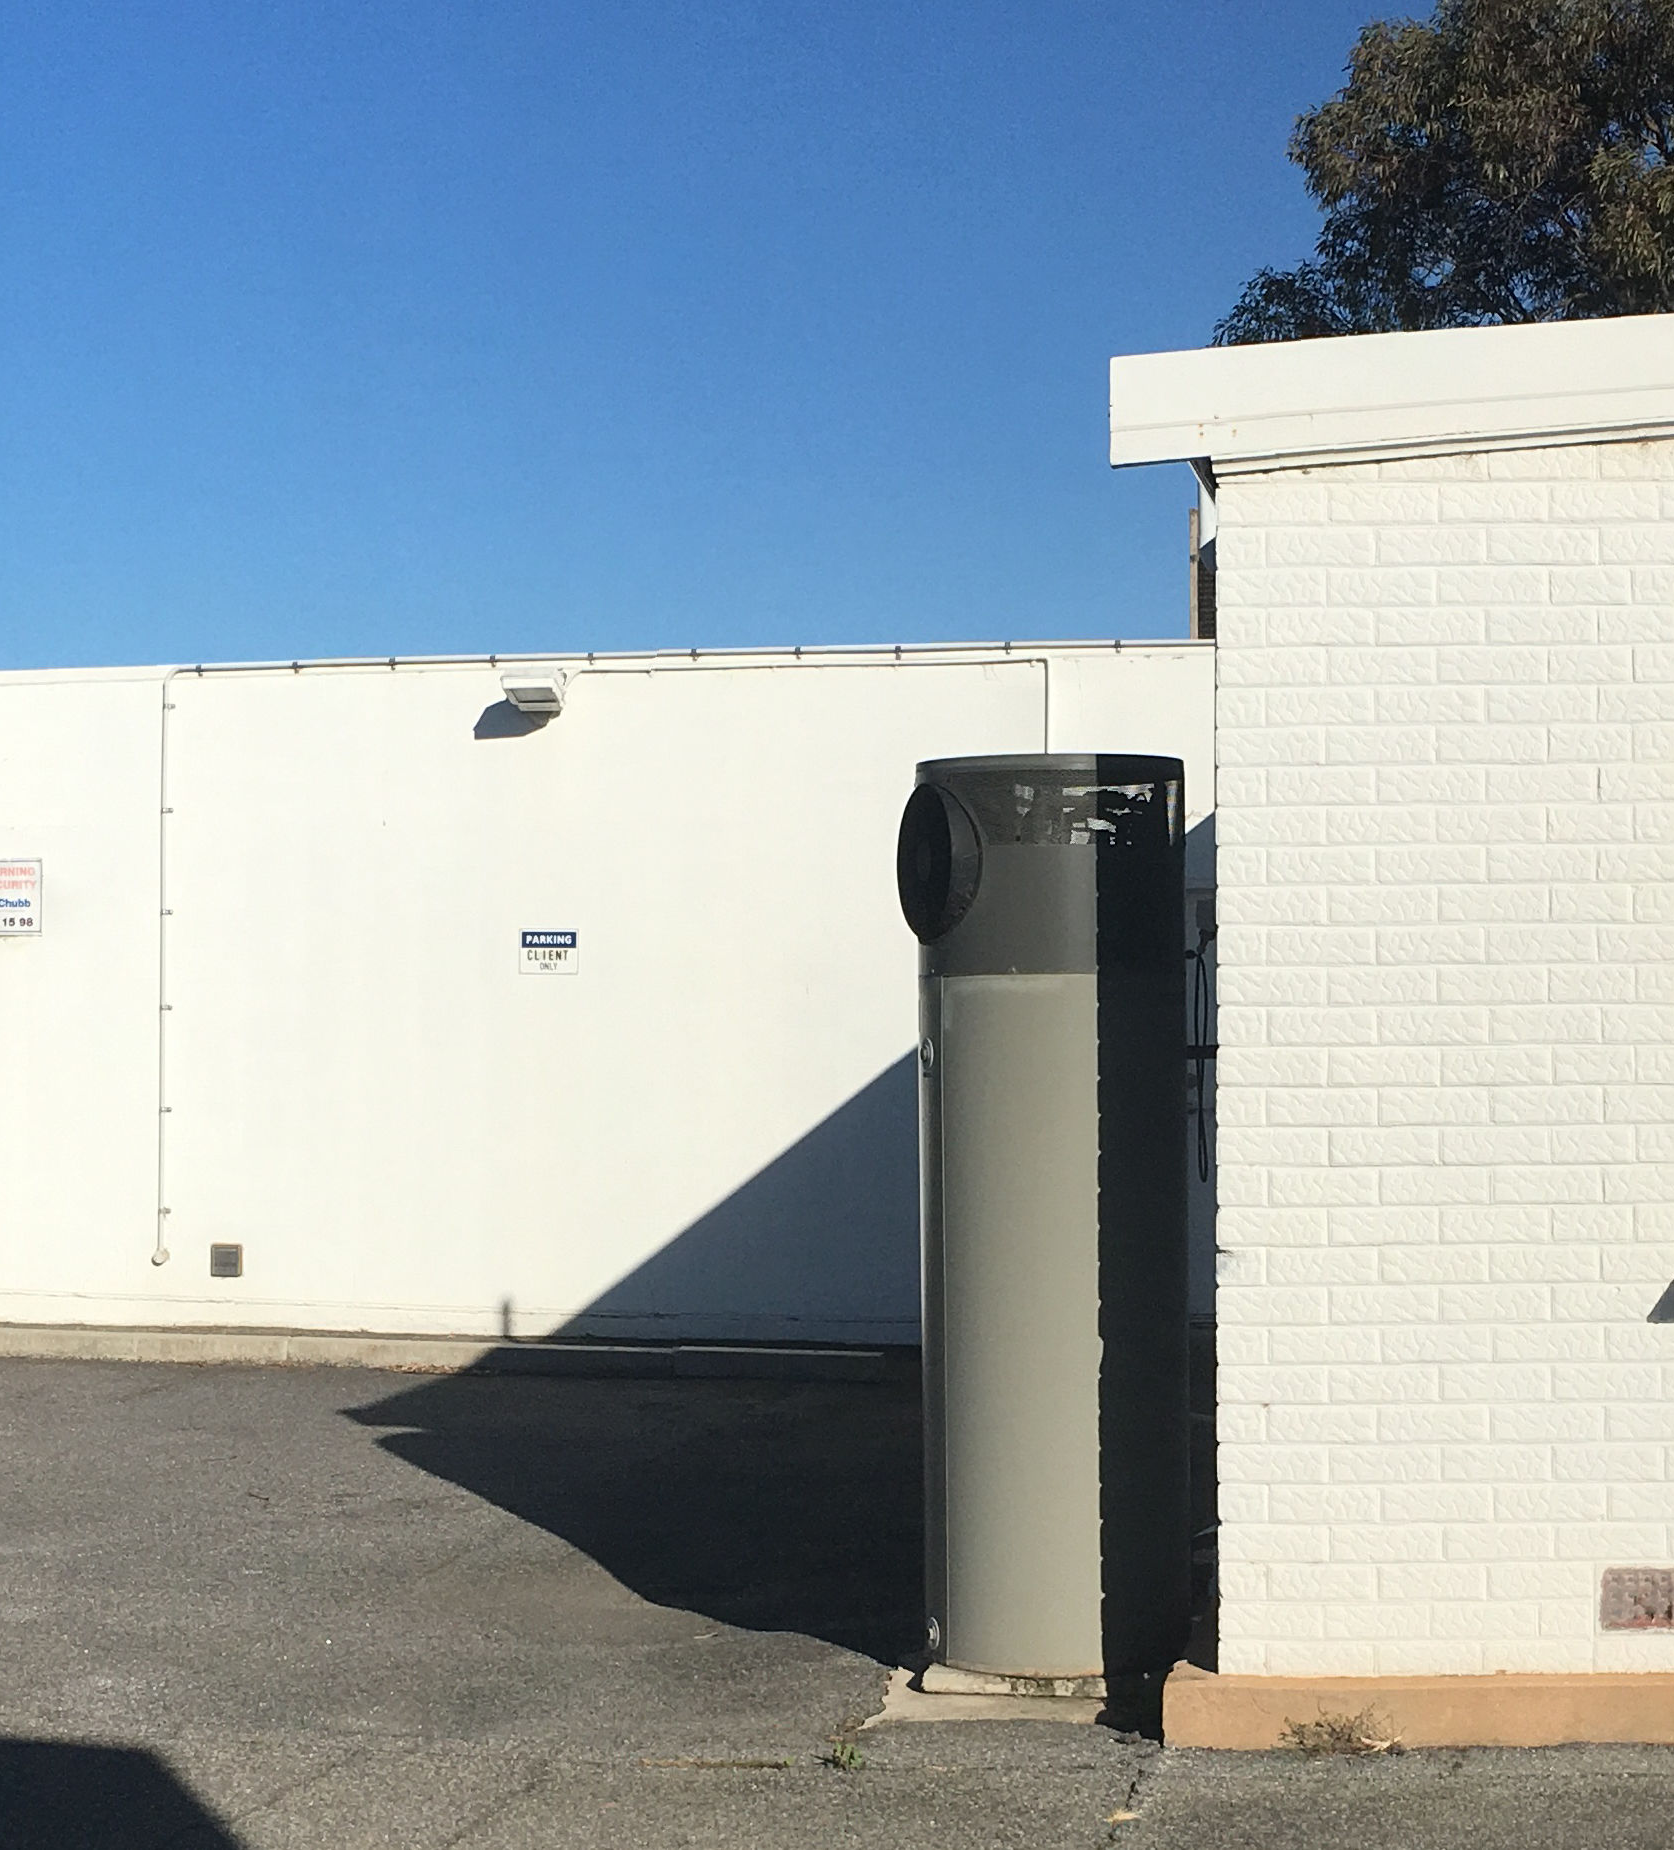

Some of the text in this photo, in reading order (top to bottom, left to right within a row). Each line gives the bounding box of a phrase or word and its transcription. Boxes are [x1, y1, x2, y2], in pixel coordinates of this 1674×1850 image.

[2, 917, 15, 927] 15
[19, 917, 33, 927] 98
[526, 934, 572, 944] PARKING
[527, 949, 568, 961] CLIENT
[539, 962, 557, 970] ONLY
